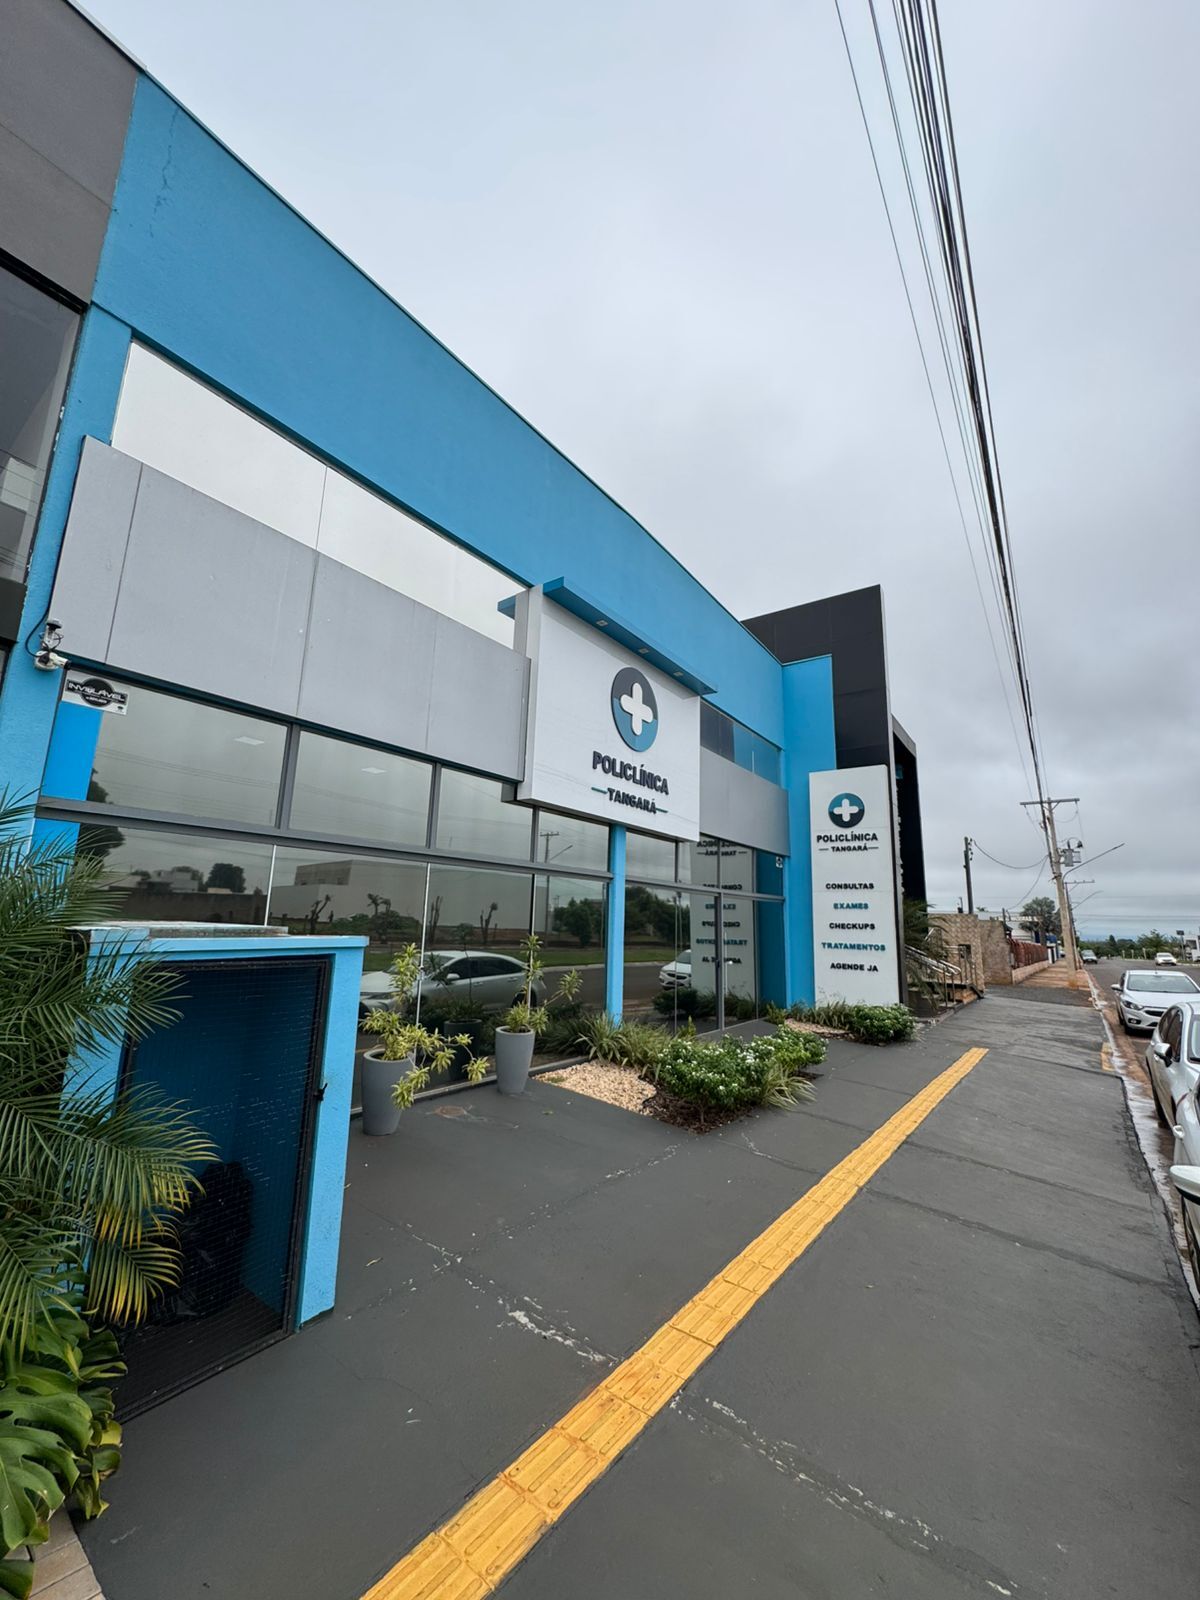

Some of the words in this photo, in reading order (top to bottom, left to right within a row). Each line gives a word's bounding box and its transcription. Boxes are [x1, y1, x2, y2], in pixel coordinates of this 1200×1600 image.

[592, 751, 669, 795] POLICLÍNICA
[607, 787, 657, 814] TANGARÁ
[816, 831, 878, 843] POLICLÍNICA
[831, 843, 868, 852] TANGARÁ
[829, 922, 876, 930] CHECKUPS
[821, 942, 886, 951] TRATAMENTOS
[830, 963, 865, 971] AGENDE
